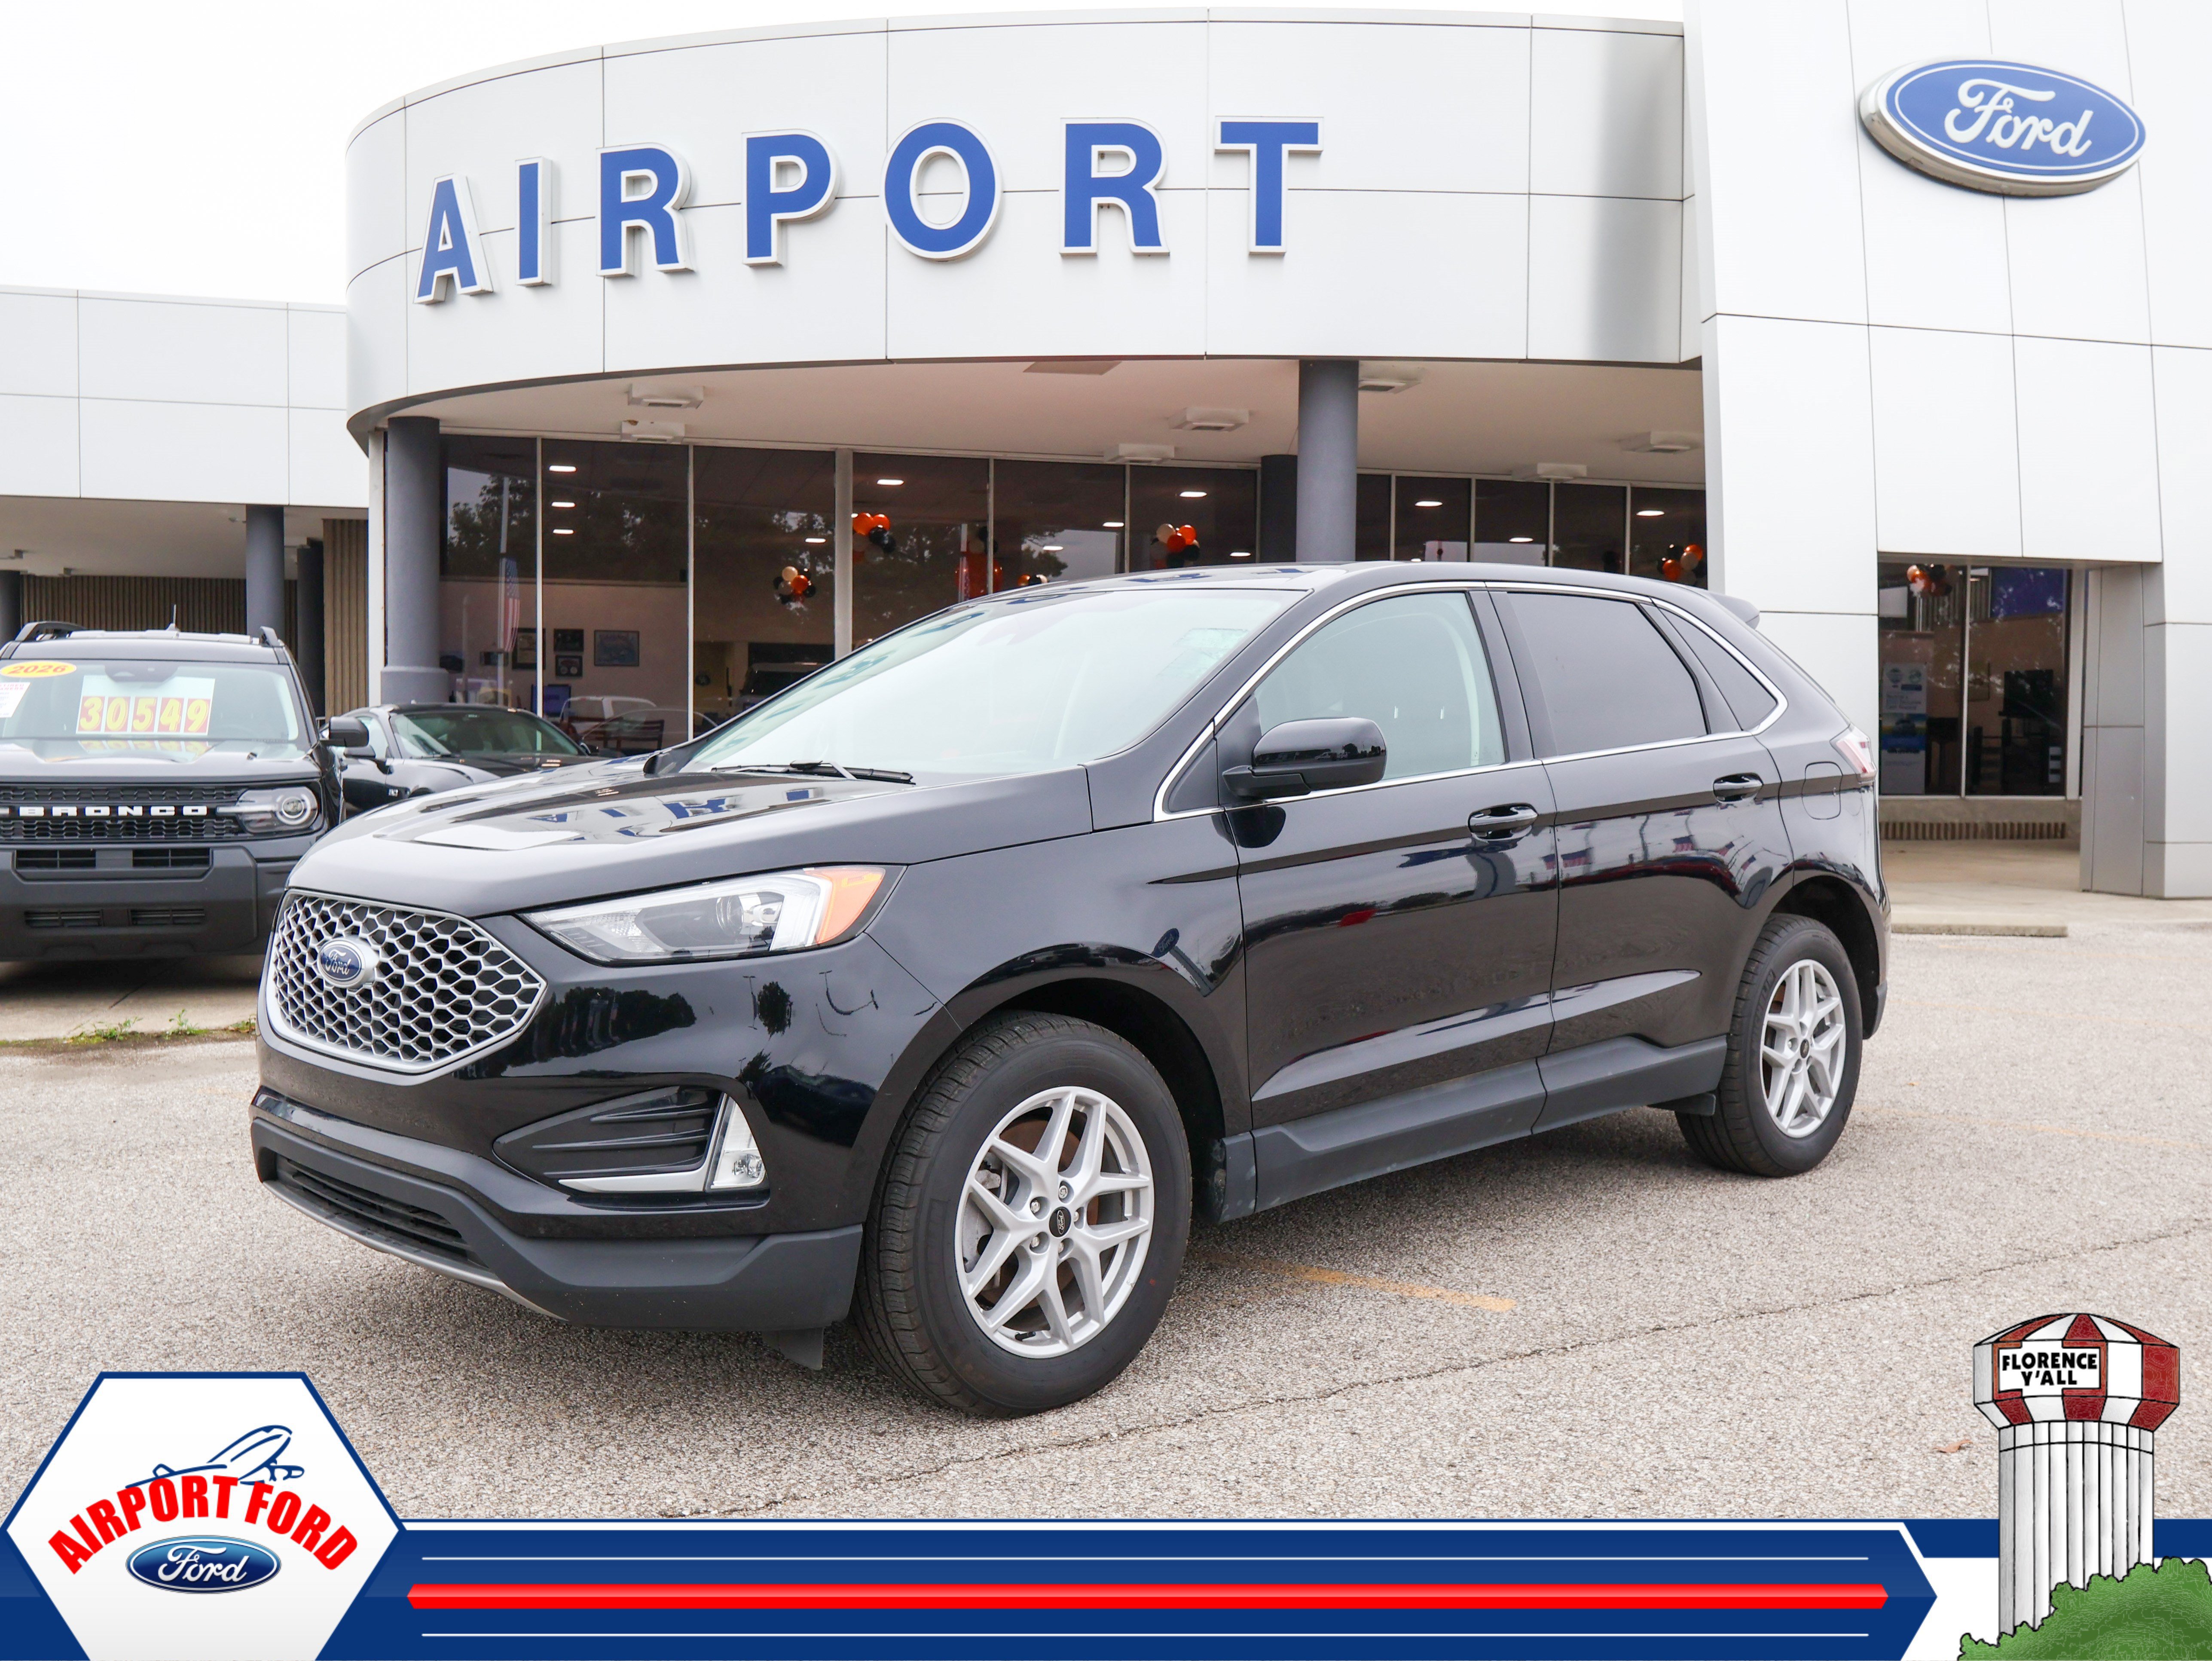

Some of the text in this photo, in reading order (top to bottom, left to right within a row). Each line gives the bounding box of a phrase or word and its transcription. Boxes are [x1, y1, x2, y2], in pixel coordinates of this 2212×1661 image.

[1944, 78, 2094, 157] Ford
[416, 118, 1323, 302] AIRPORT
[7, 665, 69, 674] 2026
[79, 697, 209, 731] 30549
[18, 805, 208, 817] BRONCO
[325, 949, 352, 976] Ford
